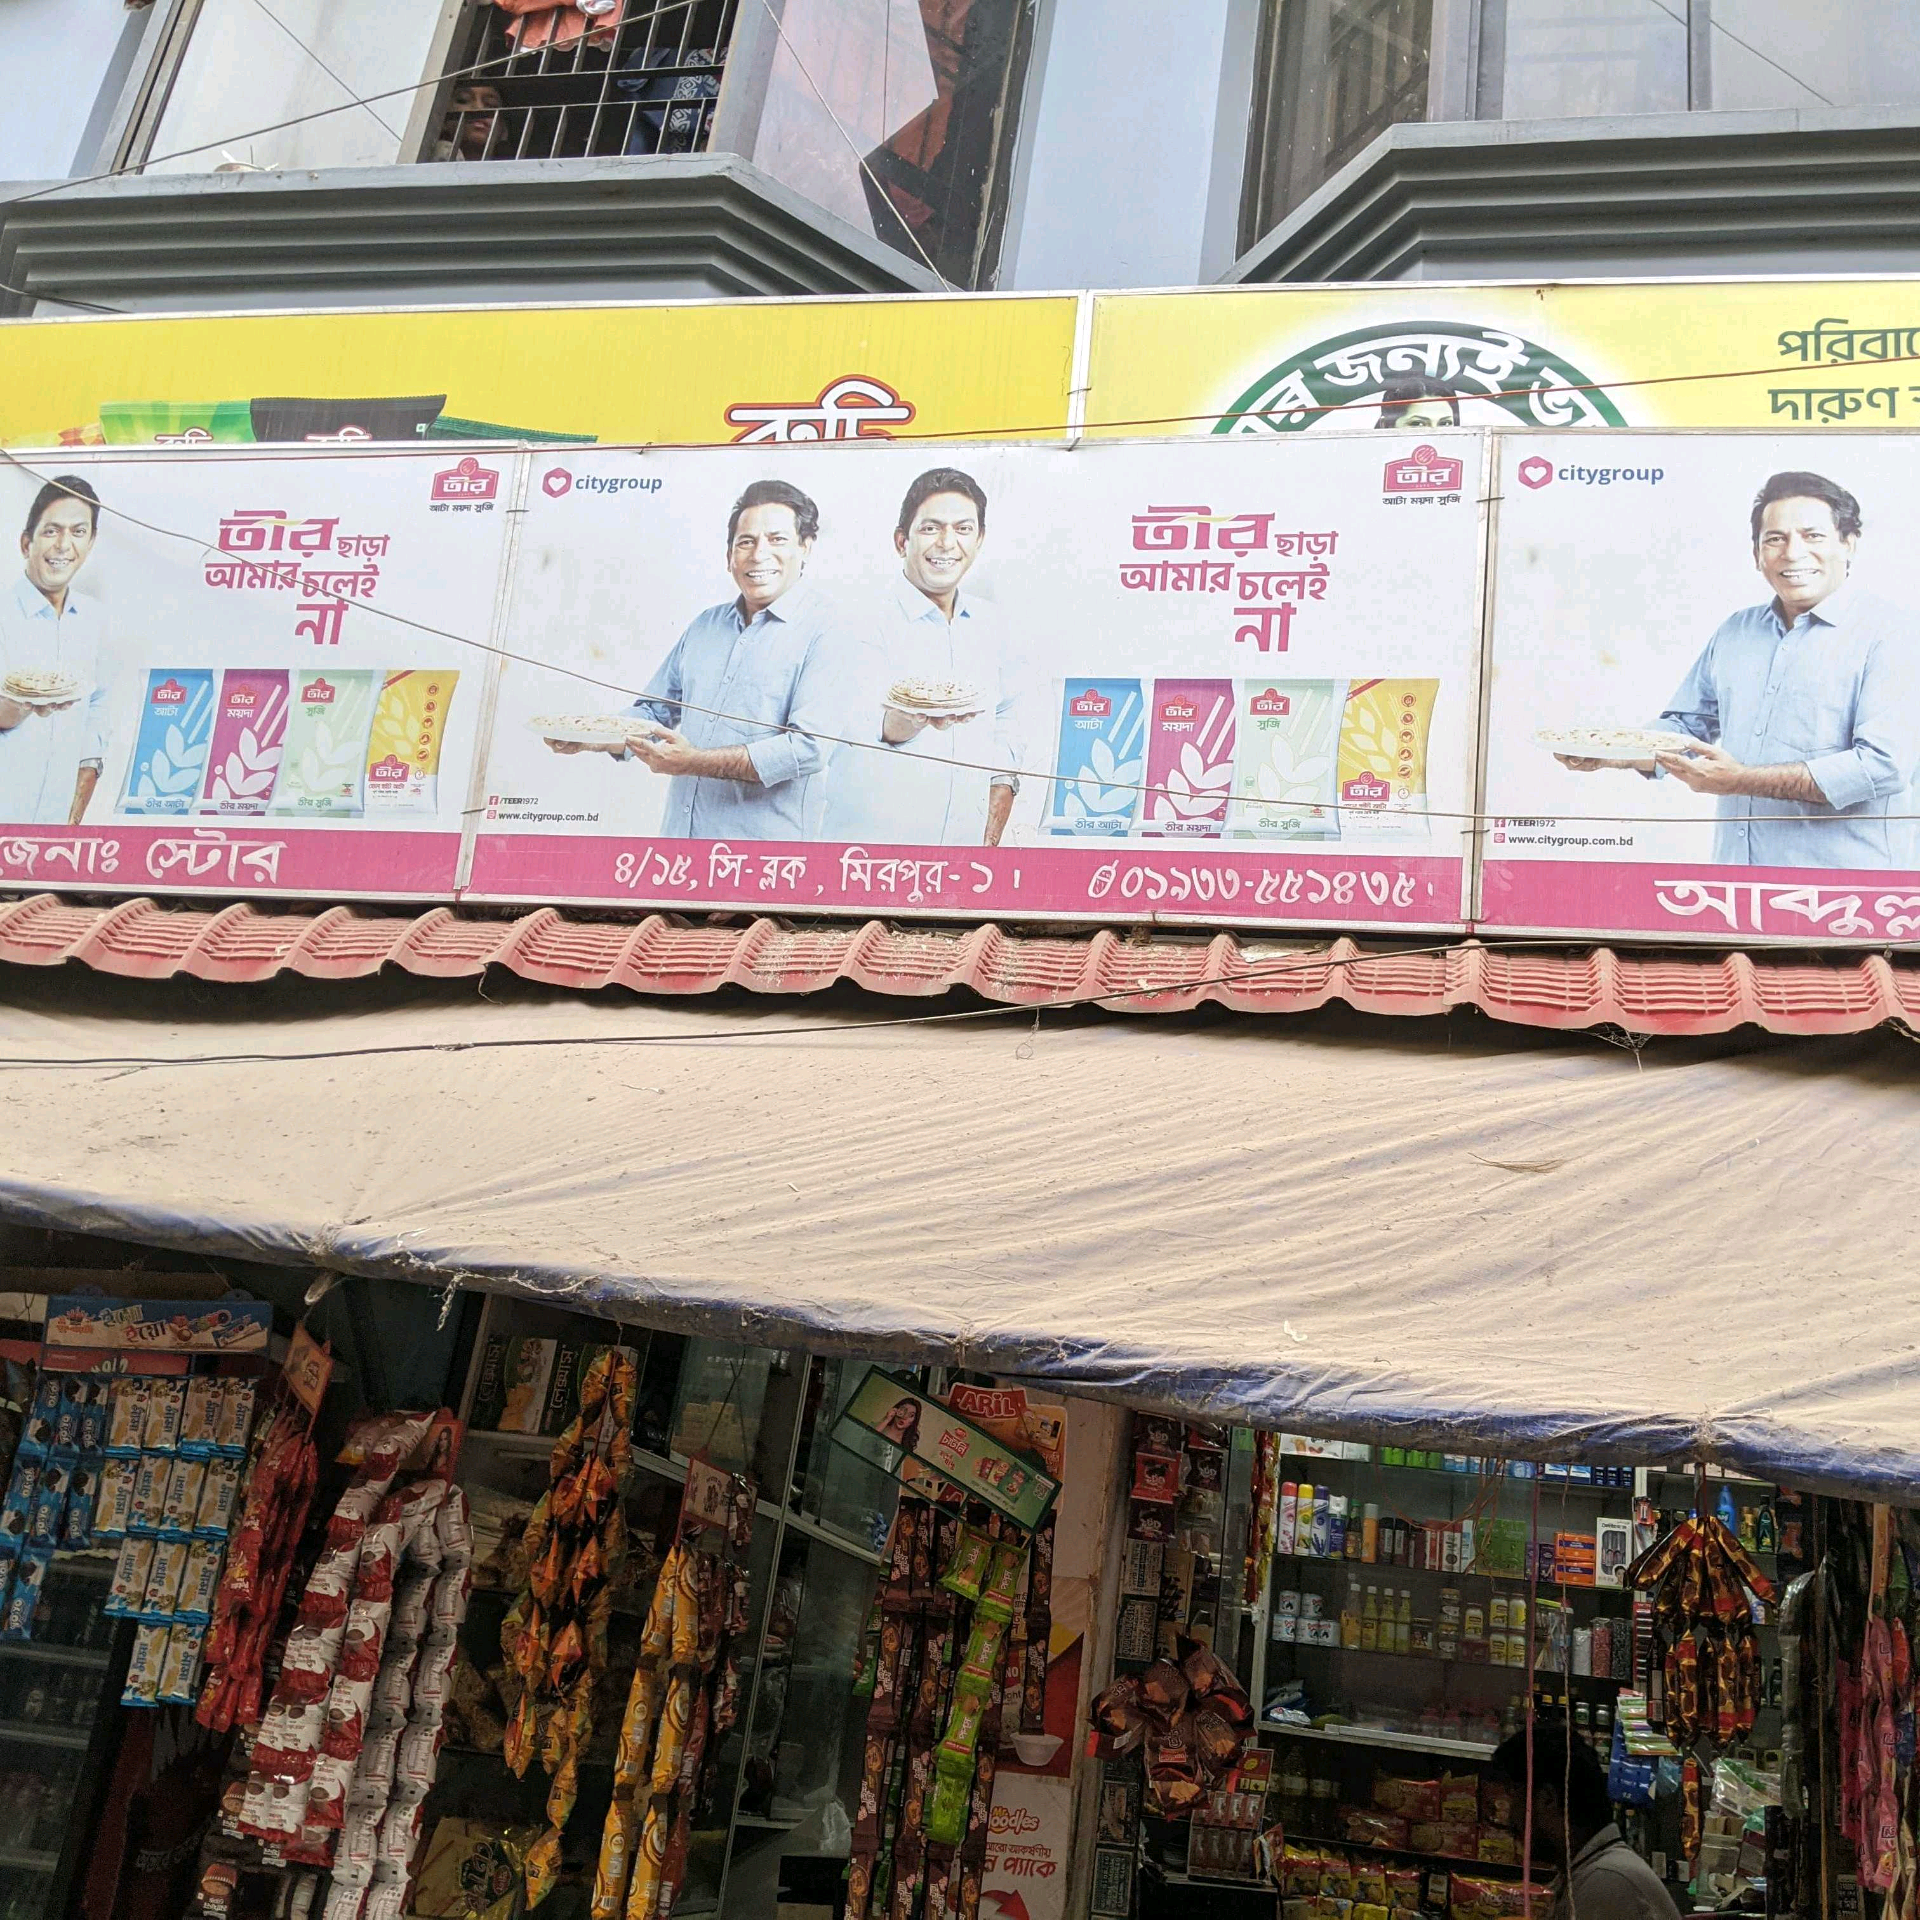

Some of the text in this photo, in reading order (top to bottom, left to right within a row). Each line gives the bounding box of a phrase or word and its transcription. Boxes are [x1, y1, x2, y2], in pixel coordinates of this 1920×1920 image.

[1767, 387, 1900, 424] দারুণ
[576, 474, 662, 493] citygroup
[1397, 466, 1452, 485] তীর
[1558, 463, 1665, 486] citygroup
[442, 476, 489, 493] তীর
[218, 509, 390, 562] তীর ছাড়া
[1132, 505, 1339, 561] তীর ছাড়া
[205, 559, 380, 598] আমার চলেই
[1119, 560, 1330, 600] আমার চলেই
[295, 599, 349, 645] না
[1234, 602, 1297, 652] না
[157, 689, 184, 701] তীর
[231, 693, 255, 705] তীর
[306, 688, 332, 701] তীর
[1076, 700, 1107, 713] তীর
[1166, 705, 1194, 719] তীর
[1256, 699, 1286, 713] তীর
[375, 766, 403, 779] তীর
[1350, 785, 1383, 798] তীর
[498, 812, 599, 823] www.citygroup.com.bd
[1508, 834, 1634, 847] www.citygroup.com.bd
[146, 829, 288, 885] স্টোর
[990, 1808, 1040, 1835] oodles
